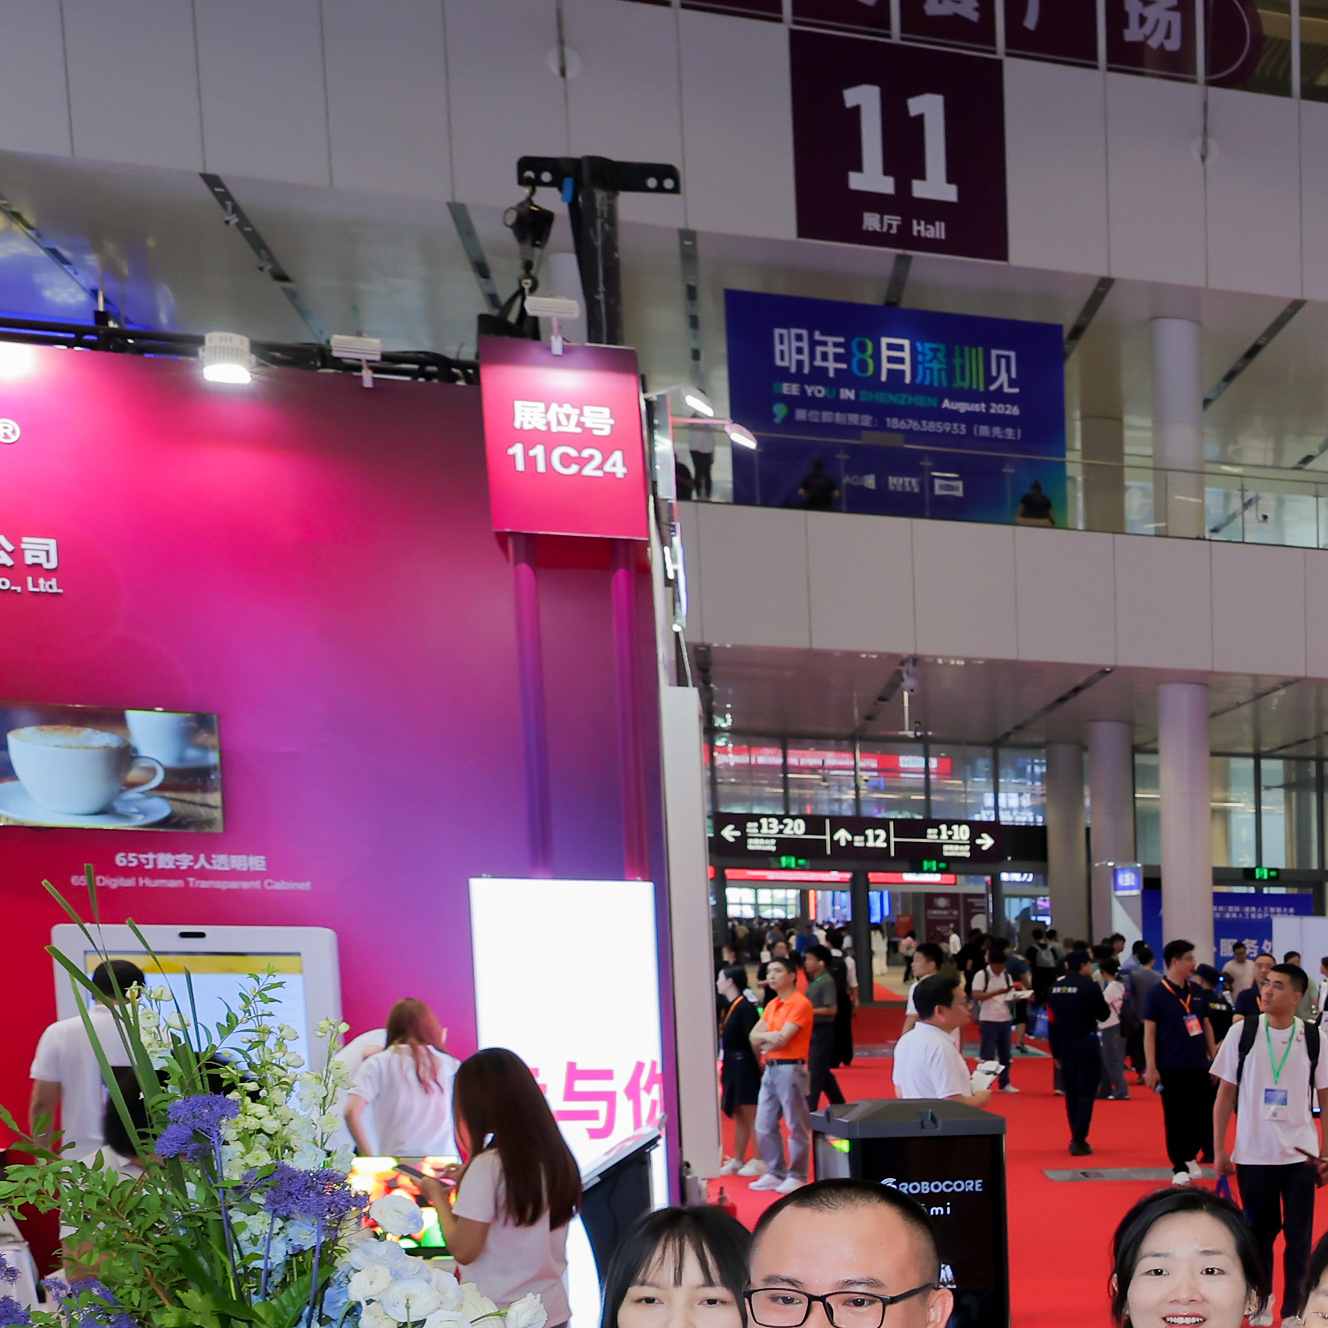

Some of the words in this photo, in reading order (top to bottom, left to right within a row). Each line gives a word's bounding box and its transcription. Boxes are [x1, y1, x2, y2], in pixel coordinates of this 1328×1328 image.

[842, 83, 959, 203] 11
[862, 212, 901, 234] 展厅
[911, 218, 946, 240] Hall
[772, 327, 1020, 394] 明年8月深圳见
[839, 386, 855, 400] IN
[941, 398, 986, 414] August
[989, 402, 1020, 416] 2026
[513, 399, 615, 437] 展位号
[506, 442, 628, 480] 11C24
[27, 576, 64, 595] Ltd.
[759, 816, 807, 835] 13-20
[865, 828, 888, 848] 12
[937, 822, 971, 841] 1-10
[898, 1179, 984, 1195] ROBOCORE
